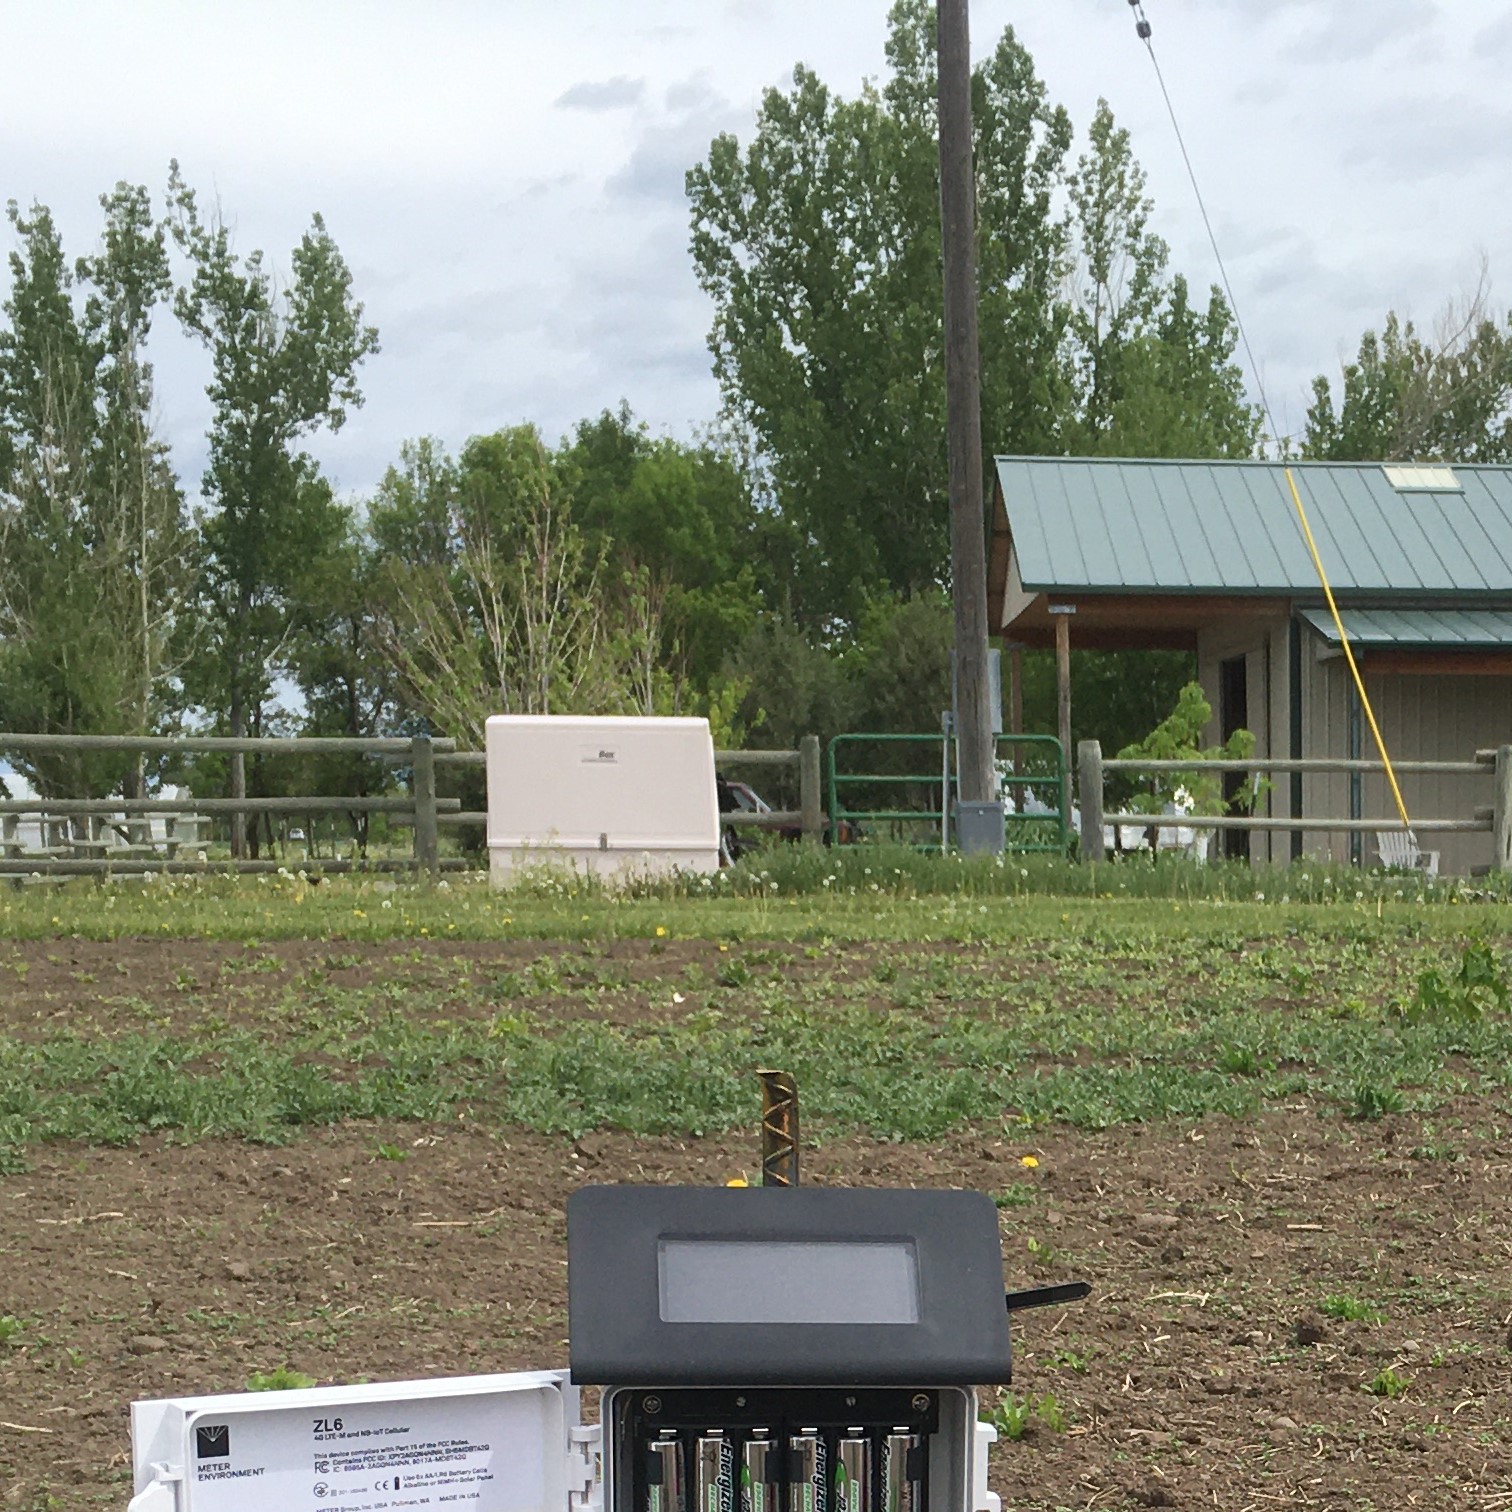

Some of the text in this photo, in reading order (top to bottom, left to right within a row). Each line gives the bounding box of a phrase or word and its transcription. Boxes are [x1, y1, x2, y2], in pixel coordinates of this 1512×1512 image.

[313, 1417, 344, 1433] ZL6
[347, 1430, 360, 1439] and
[384, 1426, 411, 1435] Cellular
[313, 1452, 328, 1460] This
[328, 1451, 350, 1459] device
[350, 1448, 380, 1456] complies
[380, 1445, 395, 1453] with
[418, 1442, 426, 1450] of
[437, 1440, 450, 1448] FCC
[197, 1462, 231, 1473] METER
[332, 1457, 362, 1467] Contains
[362, 1455, 377, 1464] FCC
[198, 1467, 266, 1482] ENVIRONMENT
[374, 1501, 389, 1509] USA
[439, 1494, 458, 1502] MADE
[467, 1491, 481, 1499] USA
